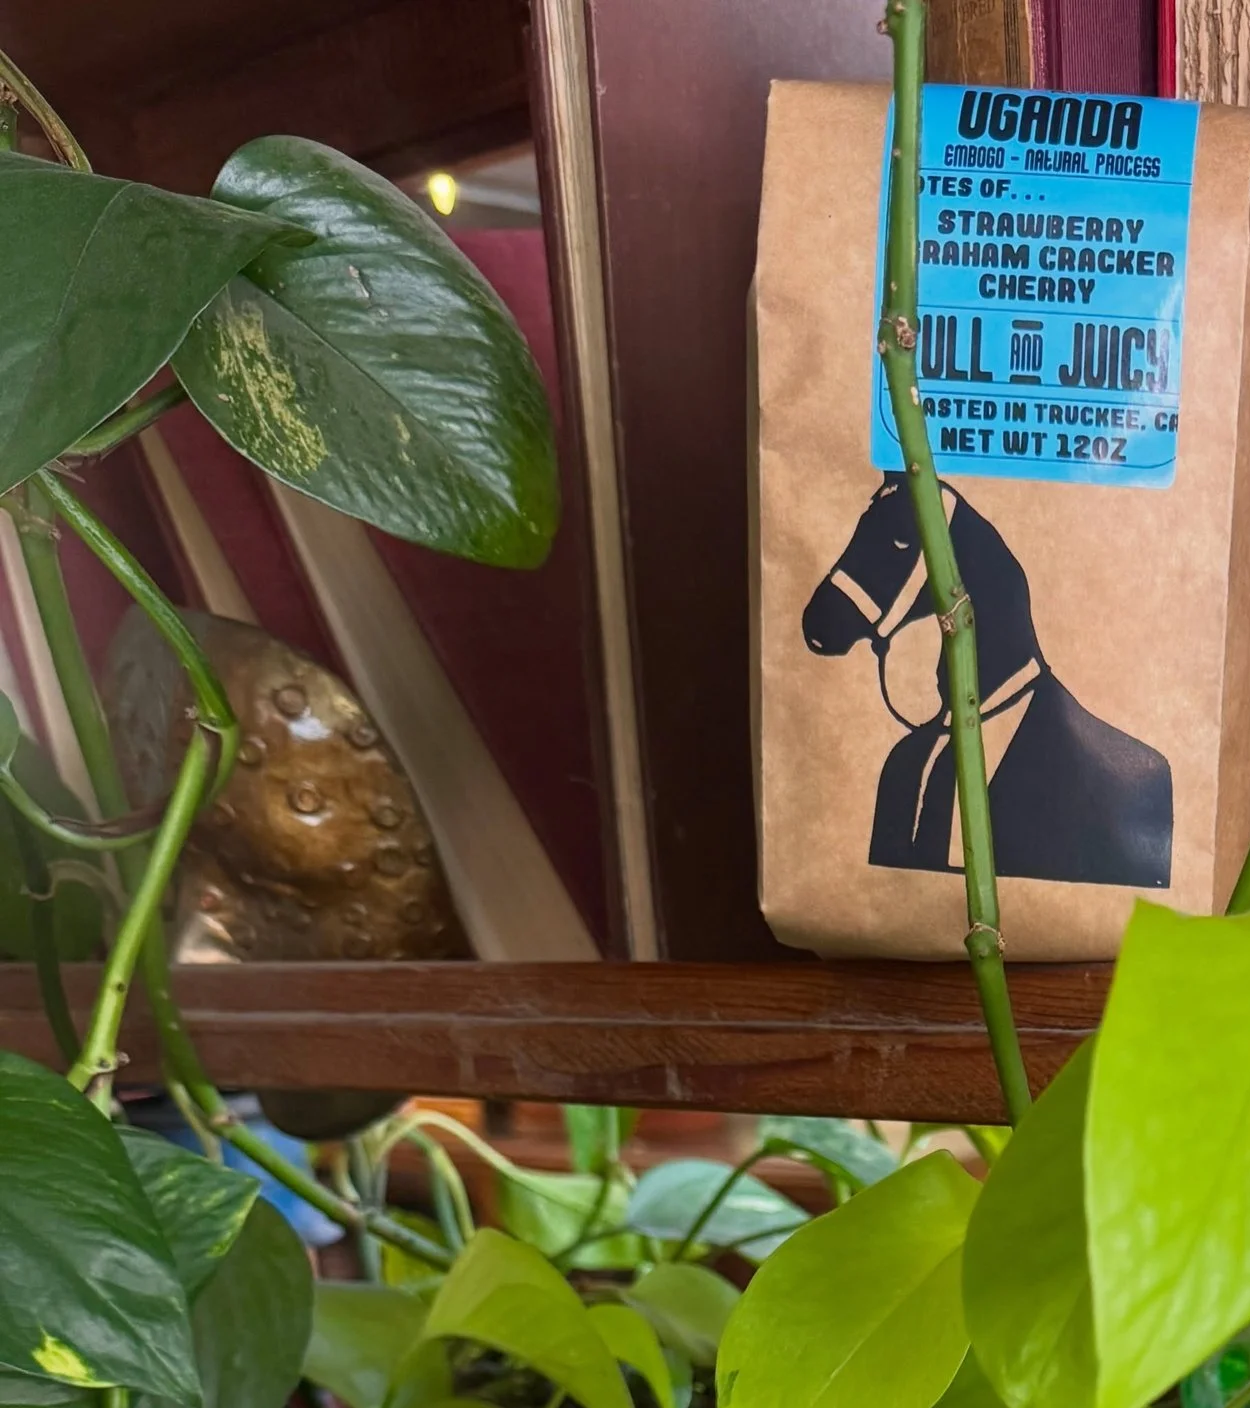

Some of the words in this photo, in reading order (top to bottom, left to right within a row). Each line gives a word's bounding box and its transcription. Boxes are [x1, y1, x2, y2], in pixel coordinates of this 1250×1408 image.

[958, 91, 1143, 150] UGANDA
[944, 144, 1005, 167] EMBOGO
[1024, 149, 1089, 174] NATURAL
[1095, 155, 1161, 178] PROCESS
[918, 175, 972, 197] TES
[938, 209, 1144, 244] STRAWBERRY
[918, 240, 1029, 269] RAHAM
[1039, 246, 1175, 277] CRACKER
[979, 274, 1095, 304] CHERRY
[918, 314, 993, 382] ULL
[1010, 333, 1043, 371] AND
[1058, 322, 1170, 392] JUICY
[923, 397, 997, 421] ASTED
[1004, 401, 1027, 423] IN
[1154, 411, 1179, 433] CA
[940, 427, 994, 453] NET
[1002, 430, 1048, 456] WT
